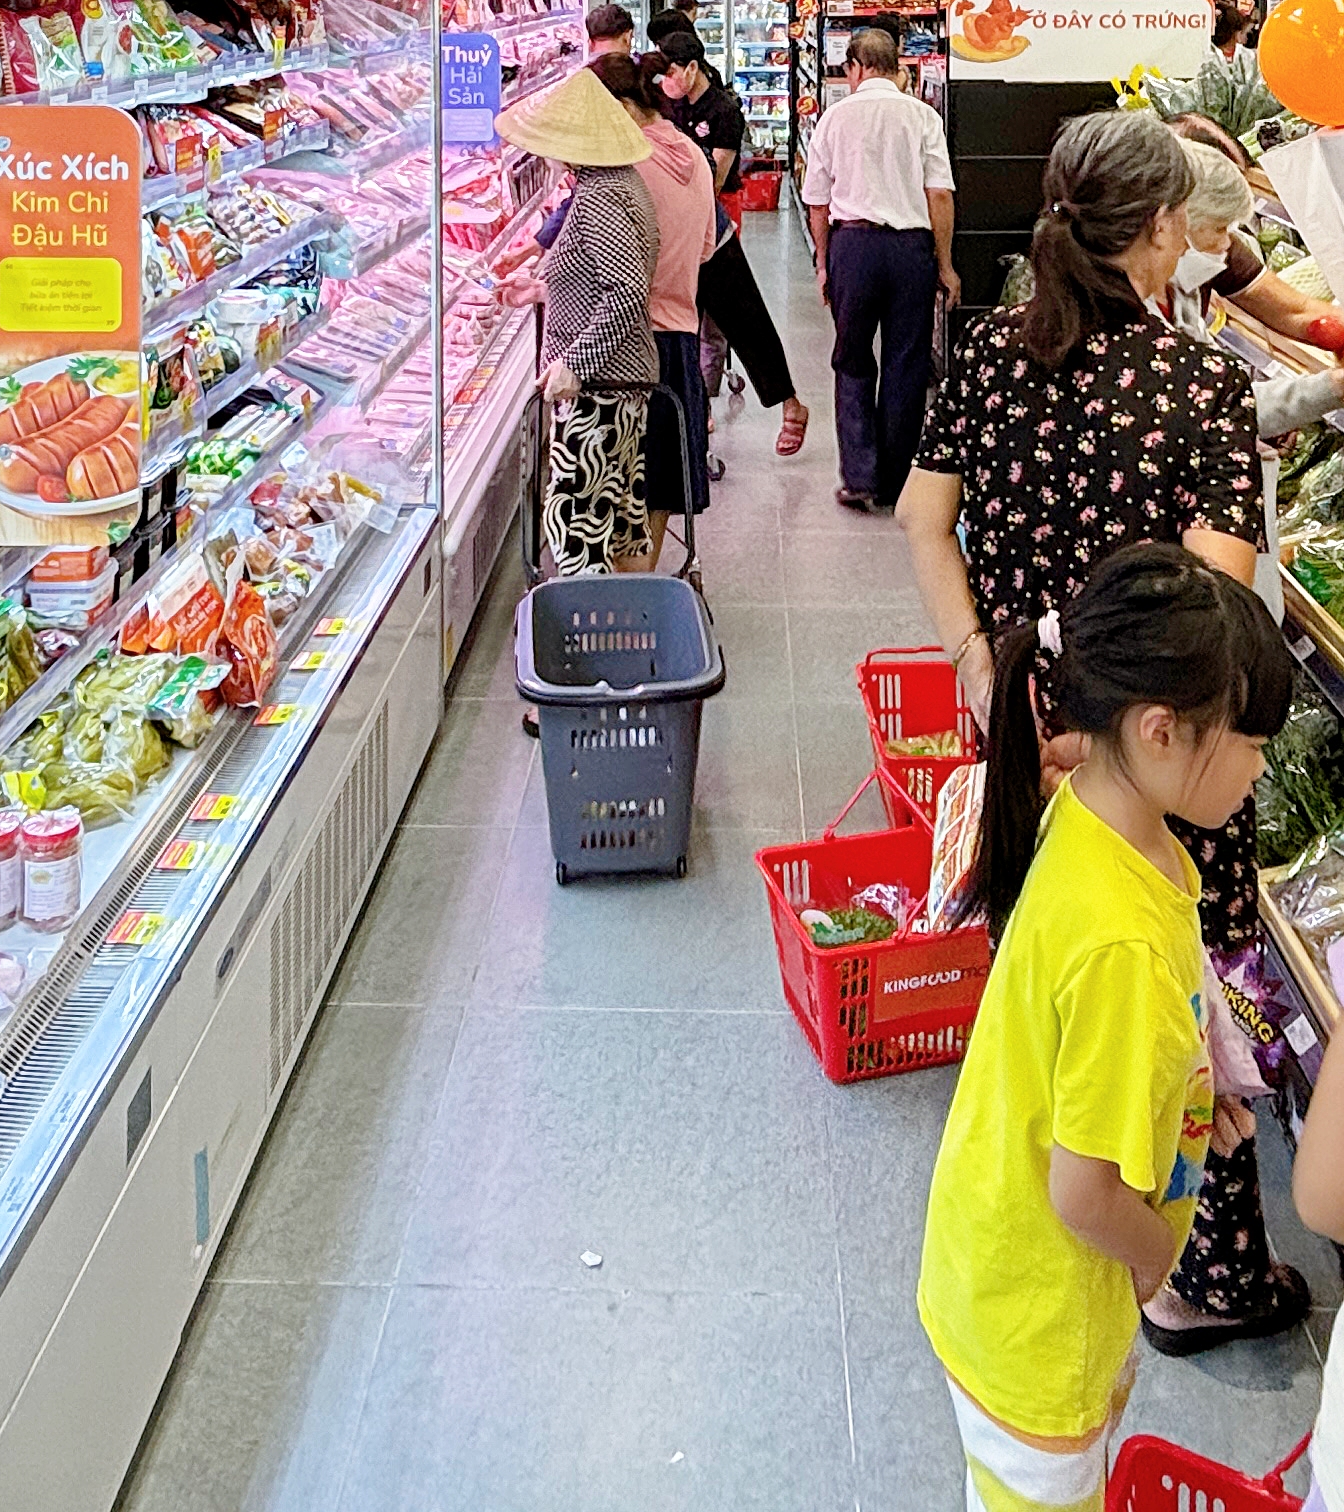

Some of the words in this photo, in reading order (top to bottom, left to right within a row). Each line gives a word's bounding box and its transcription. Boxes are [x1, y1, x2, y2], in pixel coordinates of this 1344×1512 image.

[1032, 10, 1048, 29] Ở
[1052, 10, 1093, 29] ĐÂY
[1099, 9, 1126, 29] CÓ
[1132, 8, 1207, 30] TRỨNG!
[441, 43, 493, 67] Thuỷ
[449, 65, 483, 85] Hải
[447, 86, 485, 105] Sản
[60, 148, 130, 181] Xích
[11, 189, 61, 214] Kim
[67, 189, 110, 214] Chi
[11, 222, 64, 250] Đậu
[71, 222, 108, 247] Hũ
